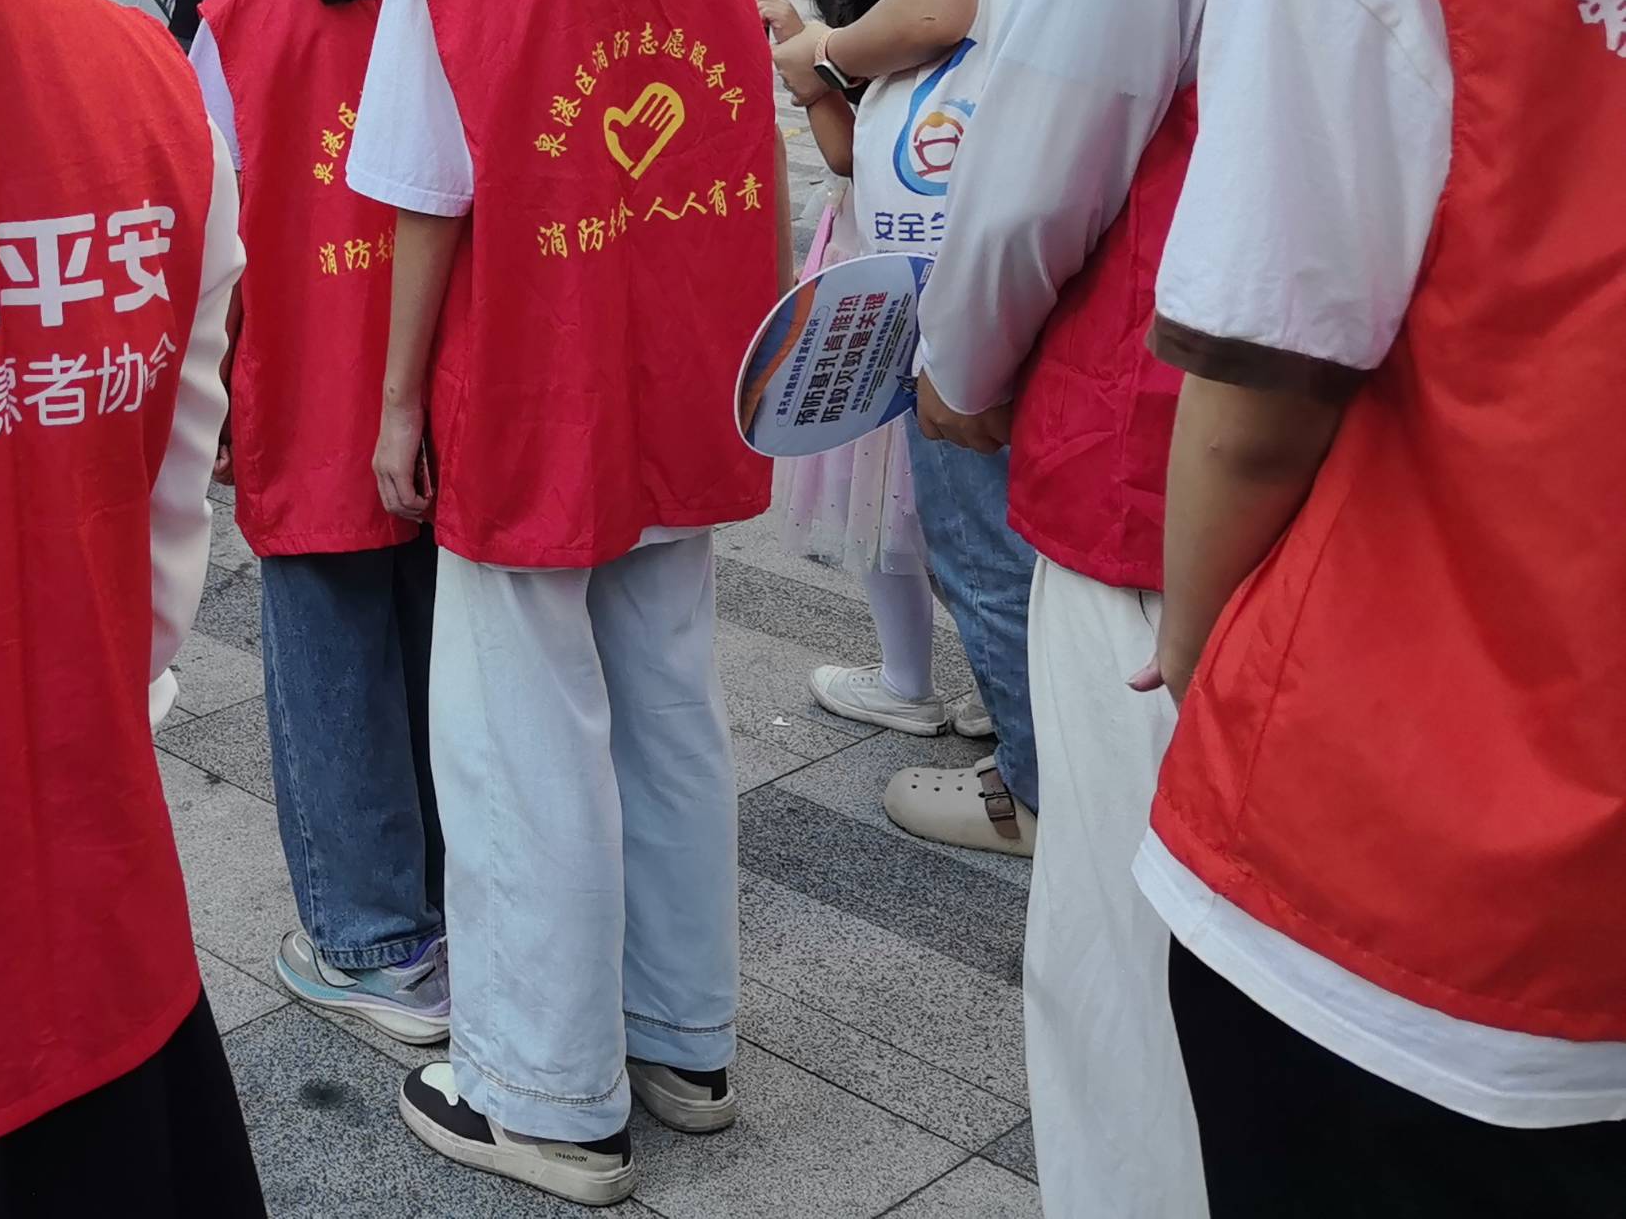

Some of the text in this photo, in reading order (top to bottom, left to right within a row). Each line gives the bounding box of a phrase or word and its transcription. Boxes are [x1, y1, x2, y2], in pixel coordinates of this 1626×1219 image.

[643, 172, 763, 222] 人人有责
[793, 293, 862, 427] 预防基孔肯雅热
[820, 291, 888, 424] 防蚊灭蚊是关键
